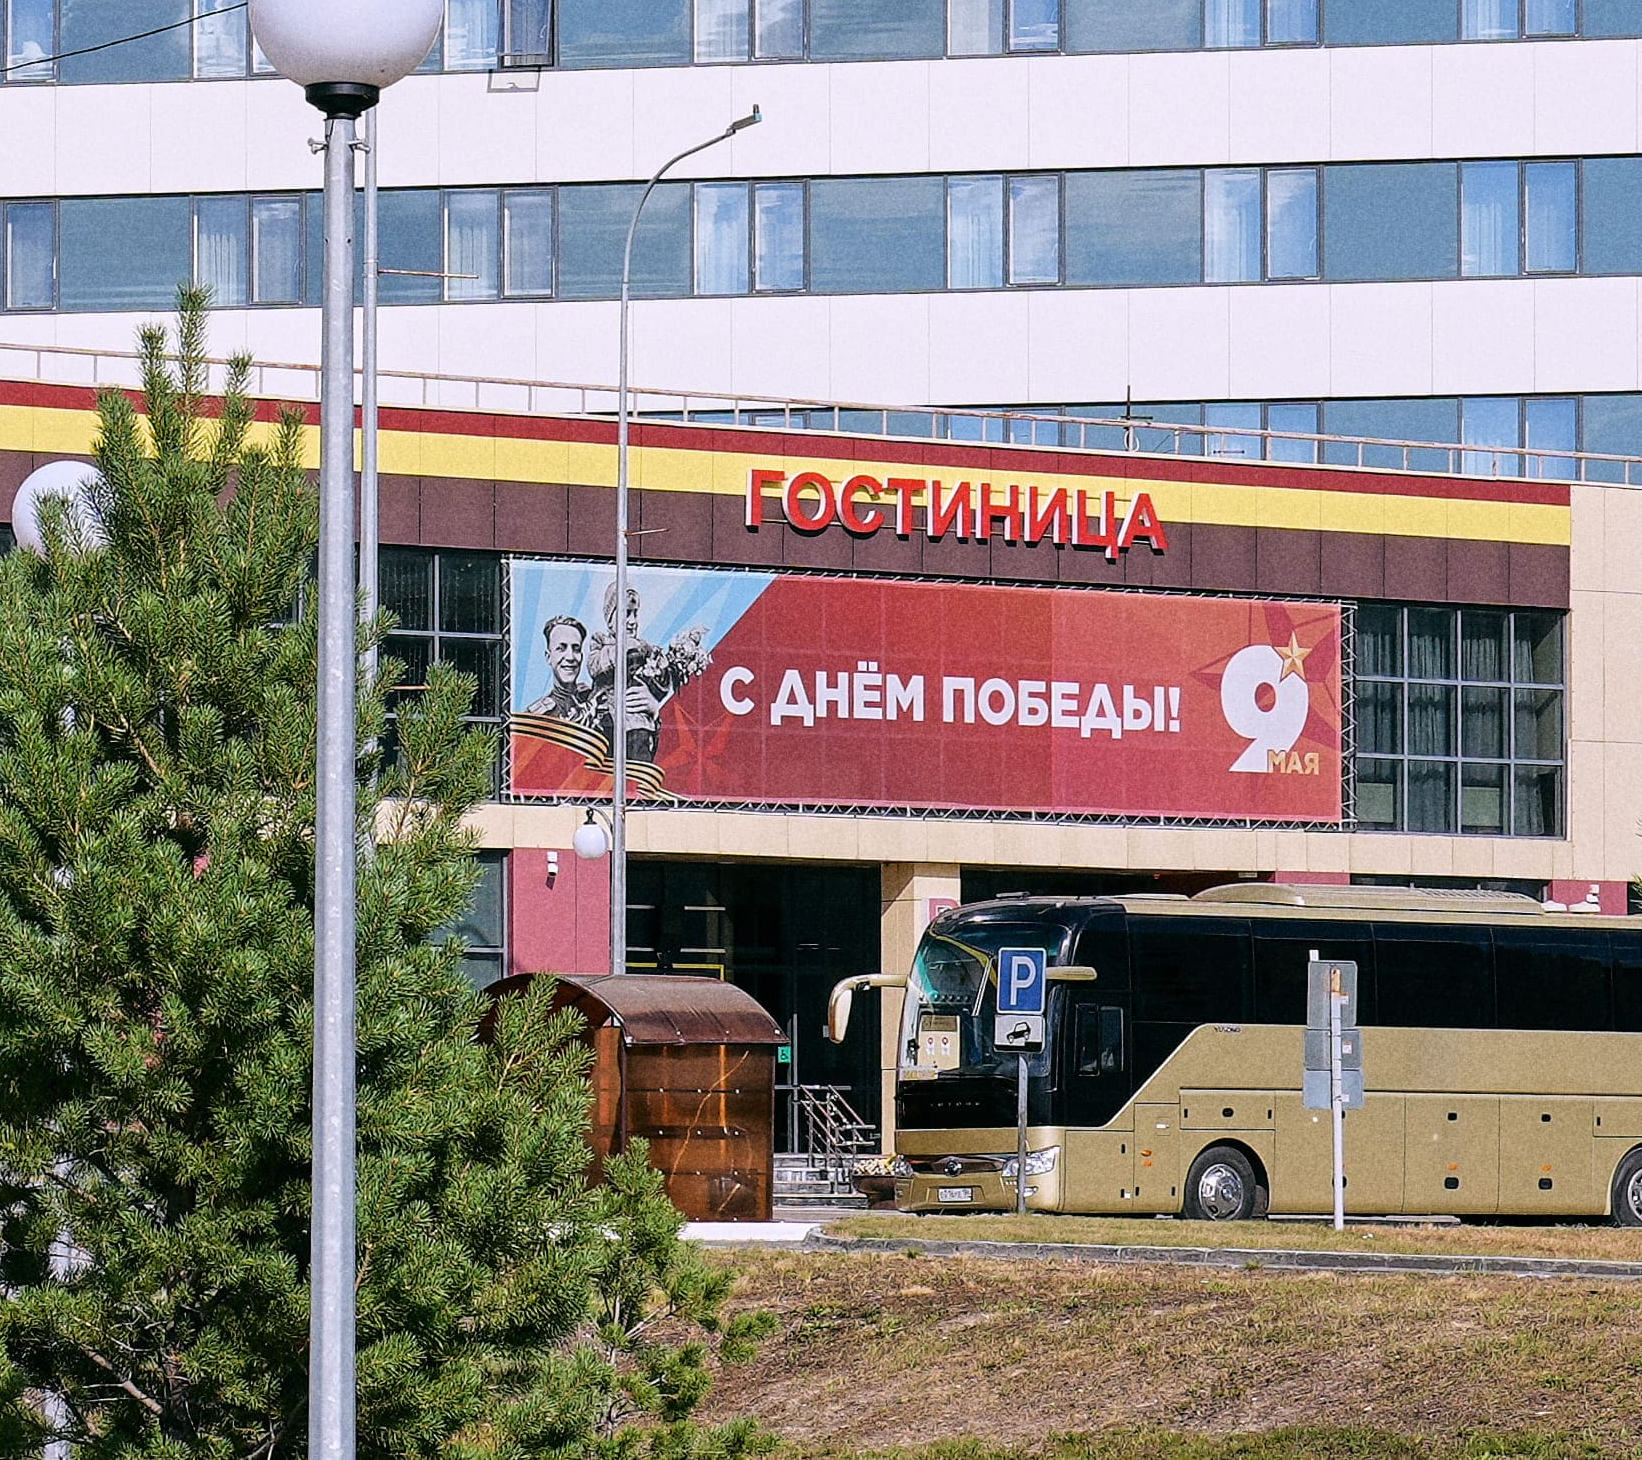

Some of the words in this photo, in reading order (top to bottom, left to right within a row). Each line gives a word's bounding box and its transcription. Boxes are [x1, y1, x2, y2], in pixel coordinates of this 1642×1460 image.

[745, 468, 1169, 559] ГОСТИНИЦА
[720, 666, 754, 715] С
[770, 659, 924, 727] ДНЁМ
[942, 676, 1181, 738] ПОБЕДЫ!
[1219, 644, 1310, 774] 9
[1268, 750, 1321, 776] МАЯ
[1010, 956, 1037, 1005] P
